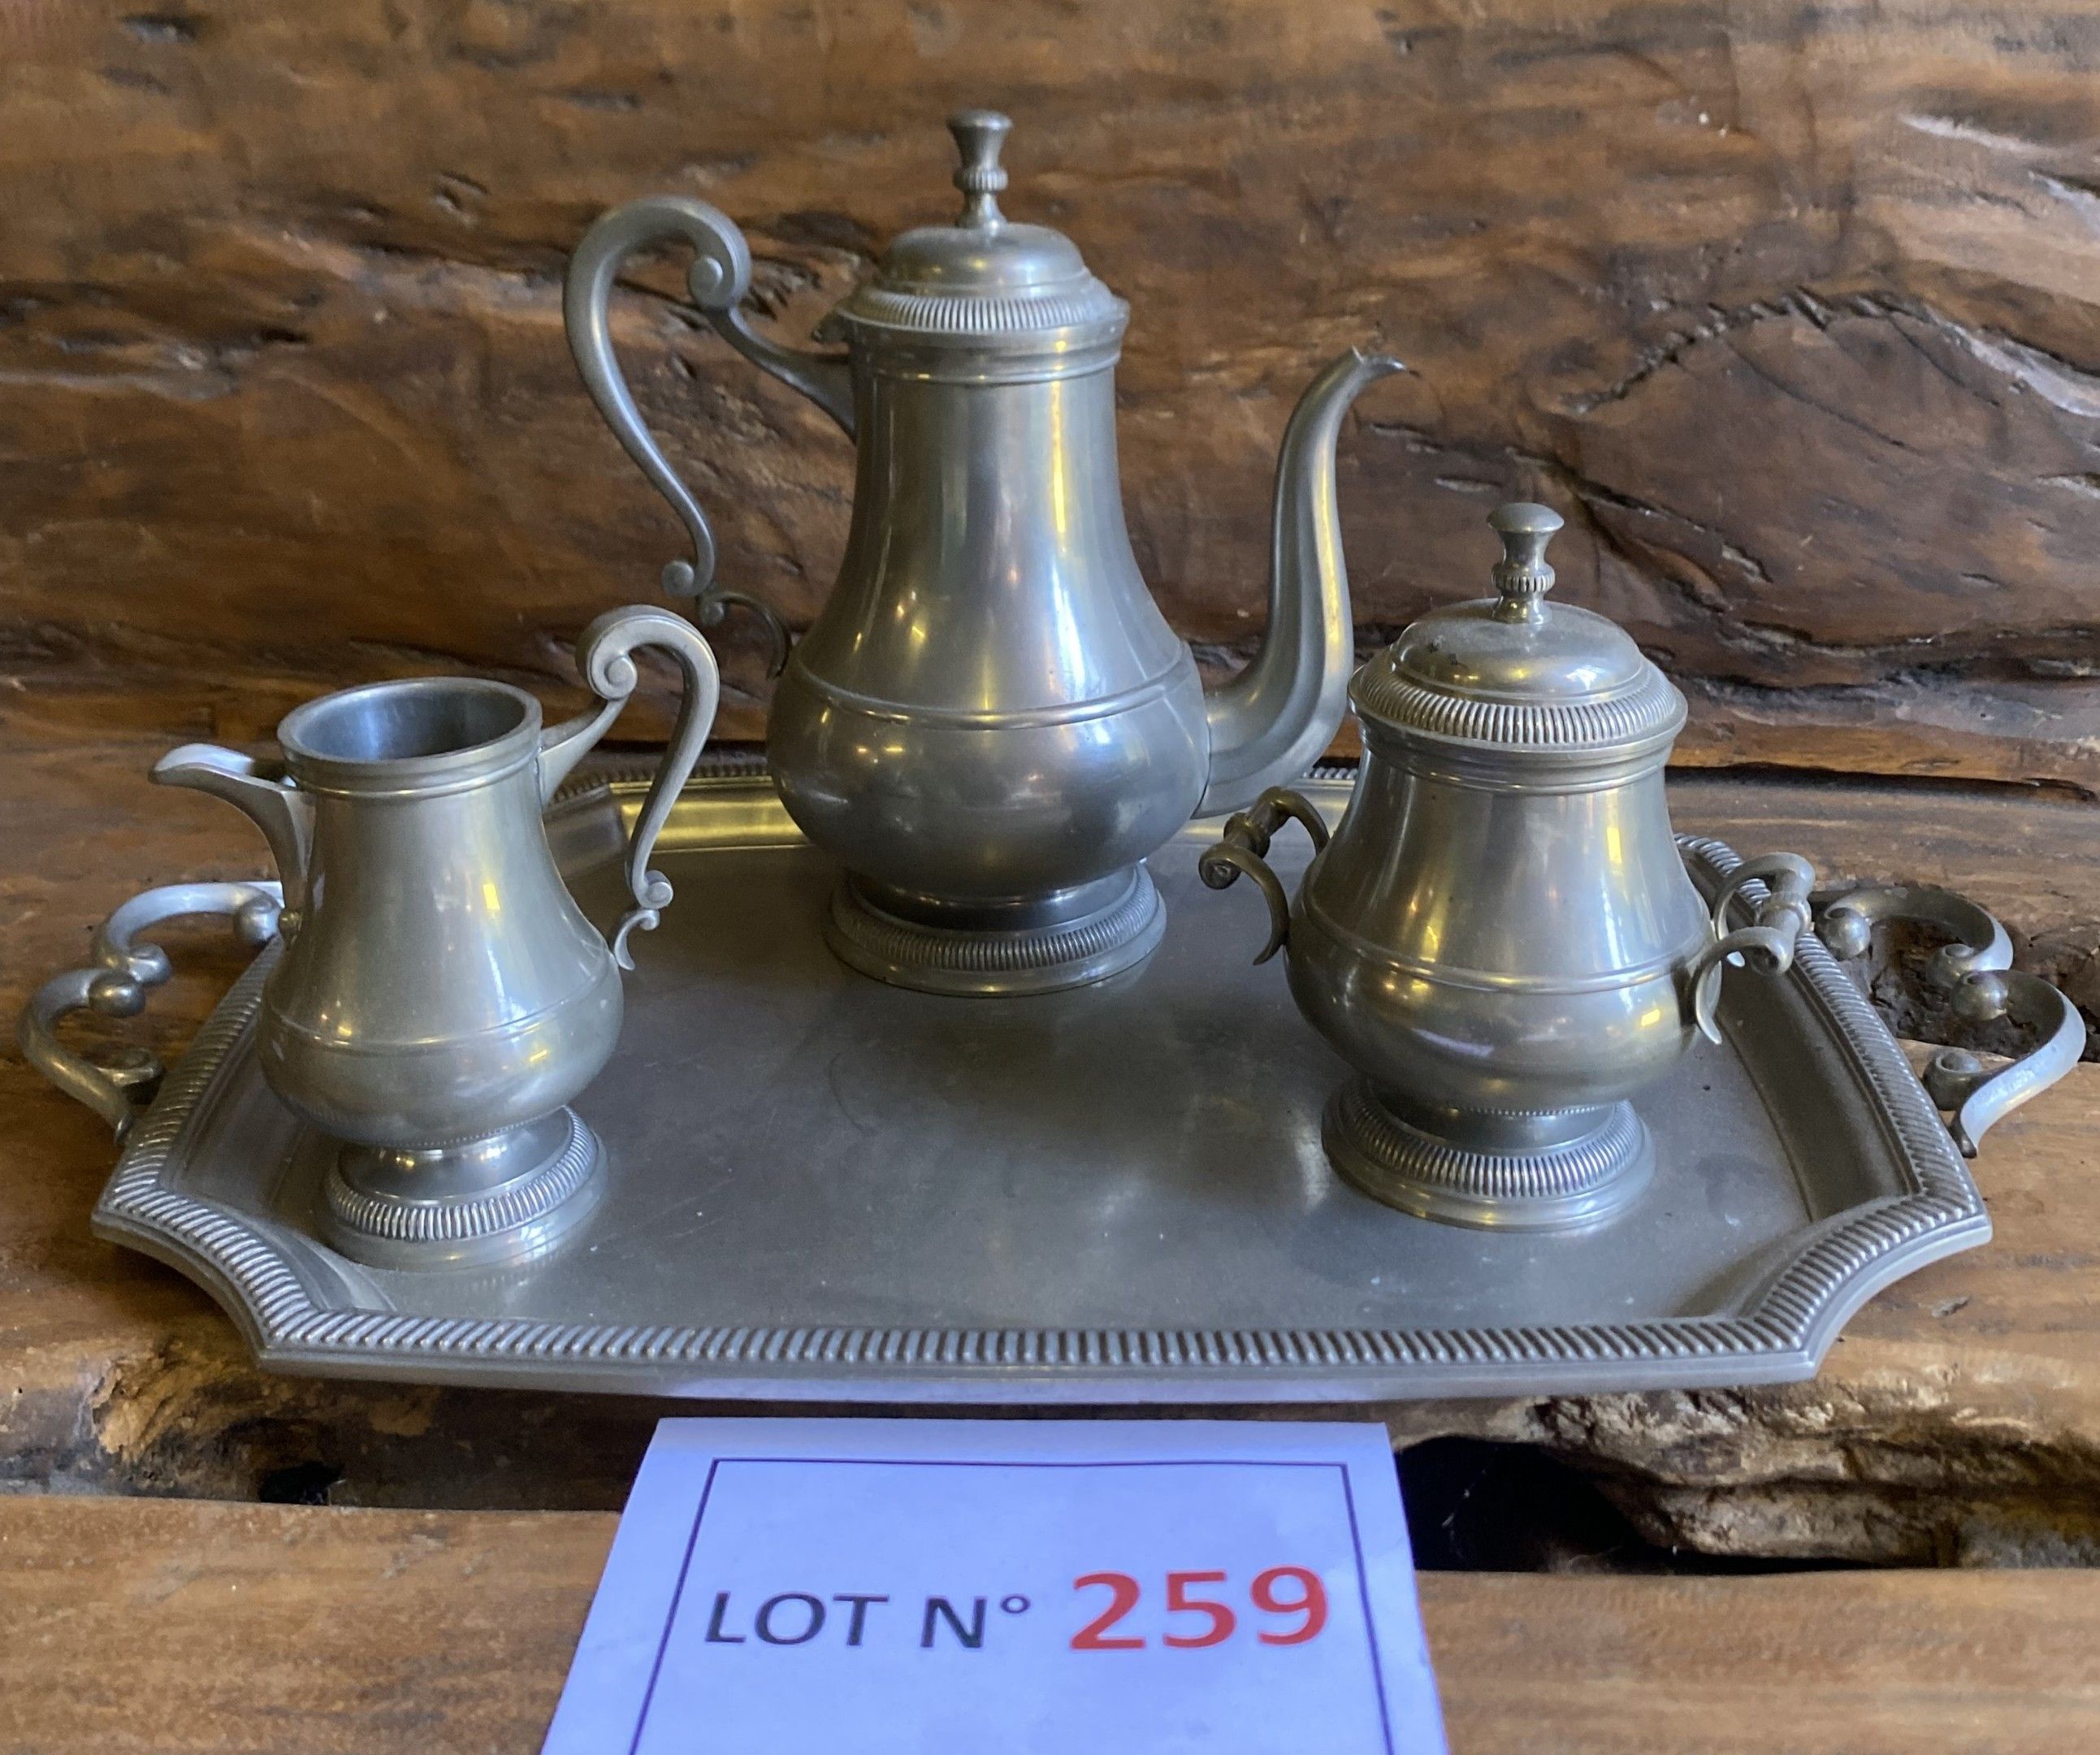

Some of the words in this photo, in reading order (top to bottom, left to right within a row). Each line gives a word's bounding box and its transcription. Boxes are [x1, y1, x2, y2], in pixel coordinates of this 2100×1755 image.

[705, 1591, 890, 1646] LOT
[920, 1592, 1032, 1650] N°
[1069, 1565, 1328, 1651] 259
